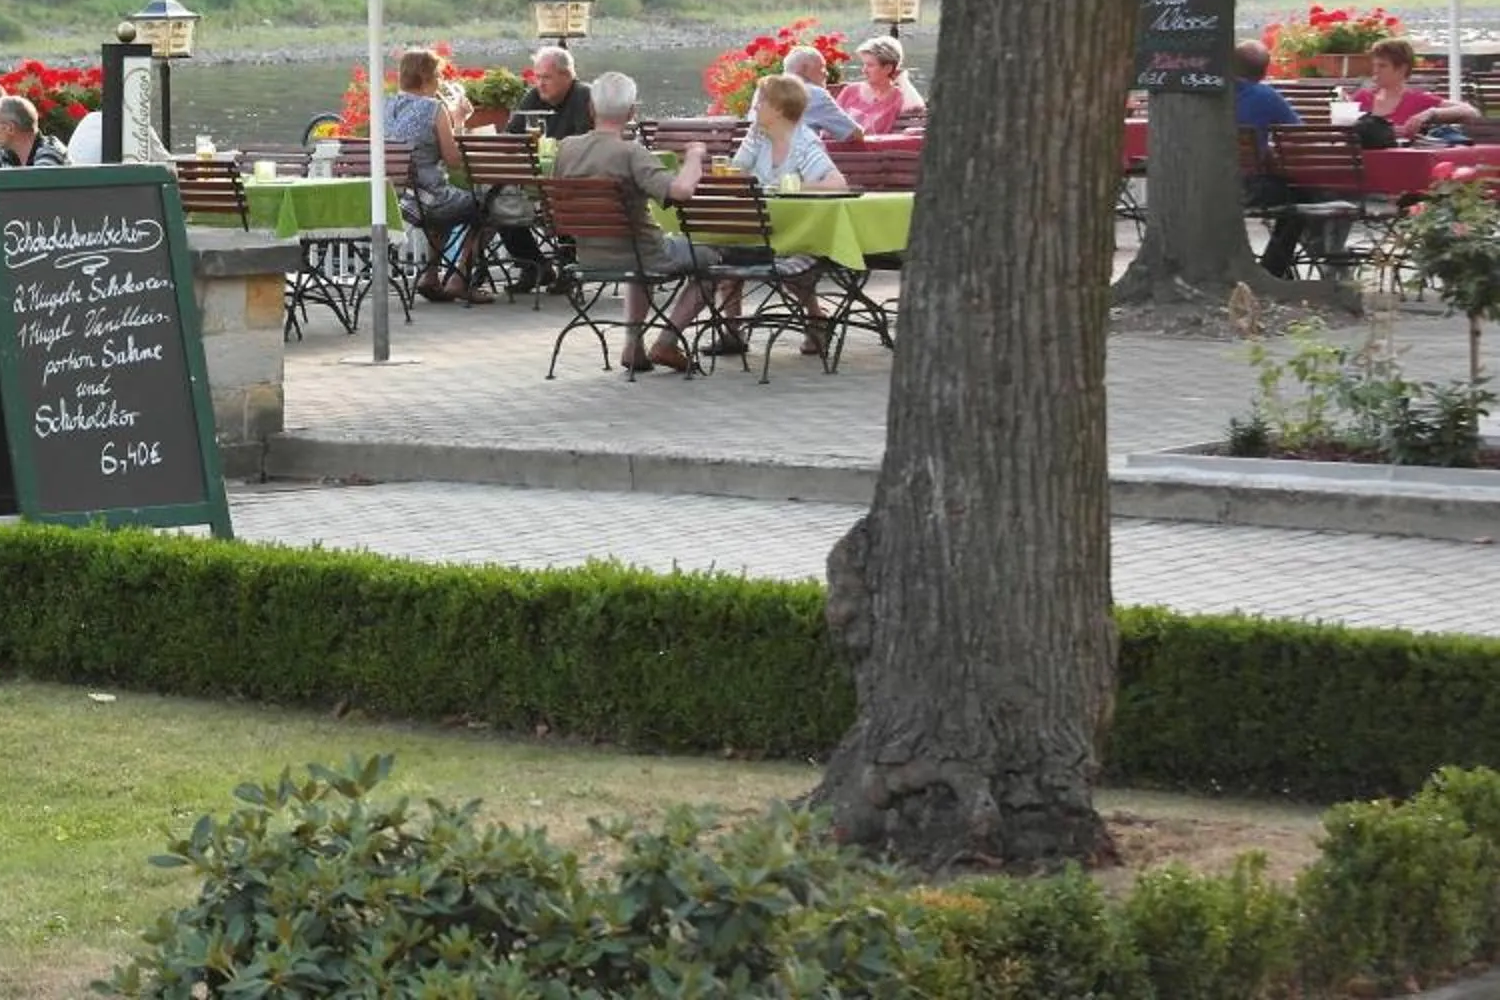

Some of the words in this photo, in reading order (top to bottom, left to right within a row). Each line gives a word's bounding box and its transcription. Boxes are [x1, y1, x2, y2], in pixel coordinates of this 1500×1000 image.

[124, 67, 151, 163] adeberger
[13, 283, 27, 313] 2
[28, 280, 82, 317] Kugeln
[17, 322, 28, 350] 1
[29, 313, 75, 353] Kugel
[101, 334, 163, 369] Sahne
[75, 373, 112, 398] und
[100, 441, 163, 476] 6,40€
